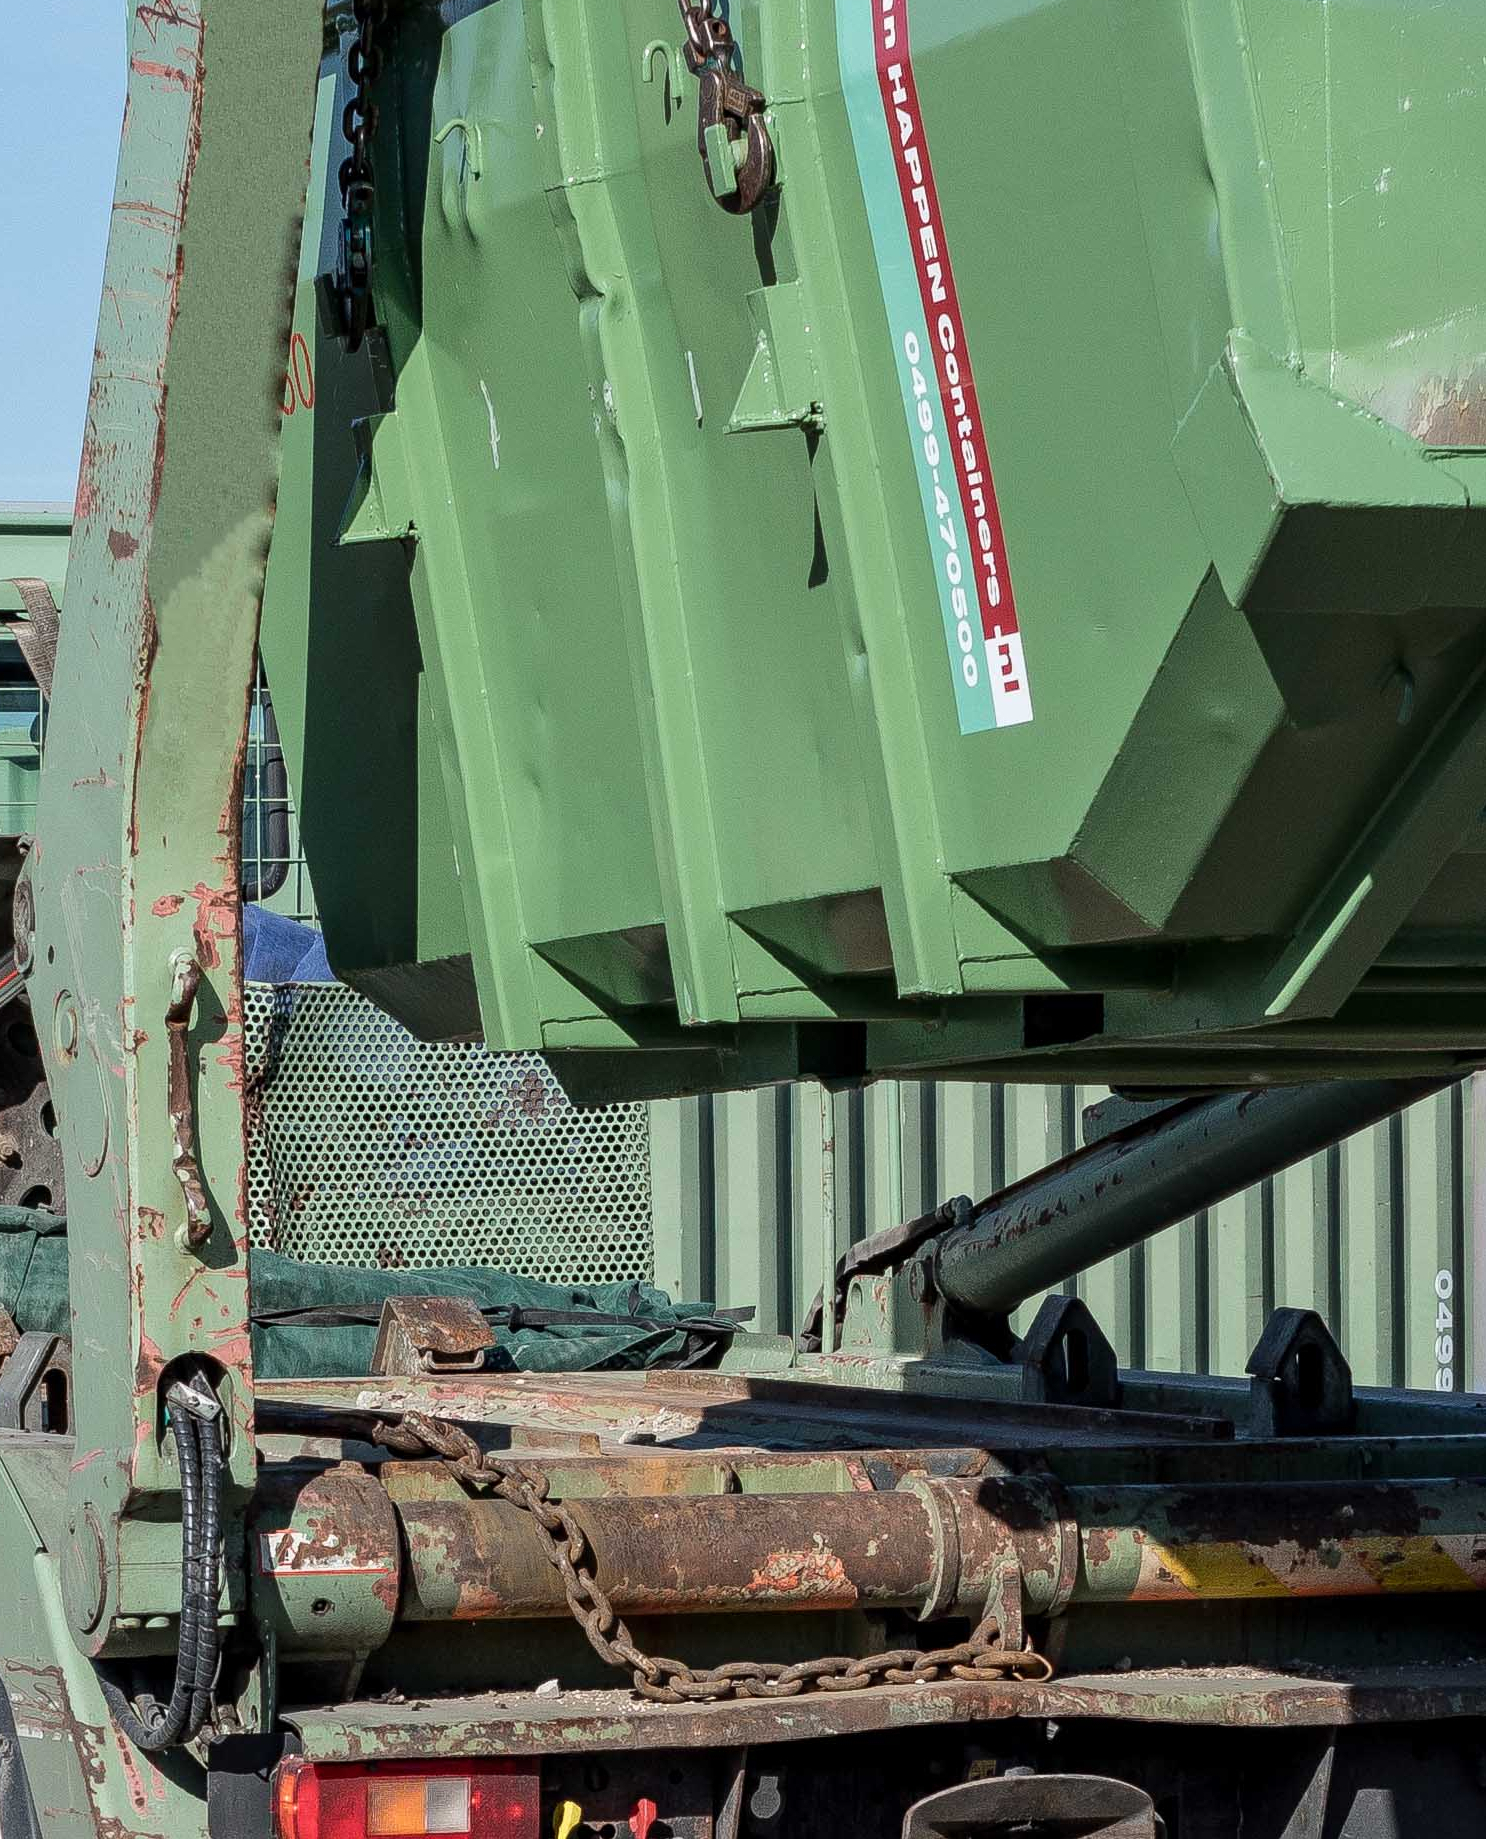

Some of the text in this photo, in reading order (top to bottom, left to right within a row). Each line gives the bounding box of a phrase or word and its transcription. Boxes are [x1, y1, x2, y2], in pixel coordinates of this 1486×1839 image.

[888, 63, 947, 303] HAPPEN
[938, 314, 1002, 608] Containers
[904, 330, 978, 688] 0499-470500
